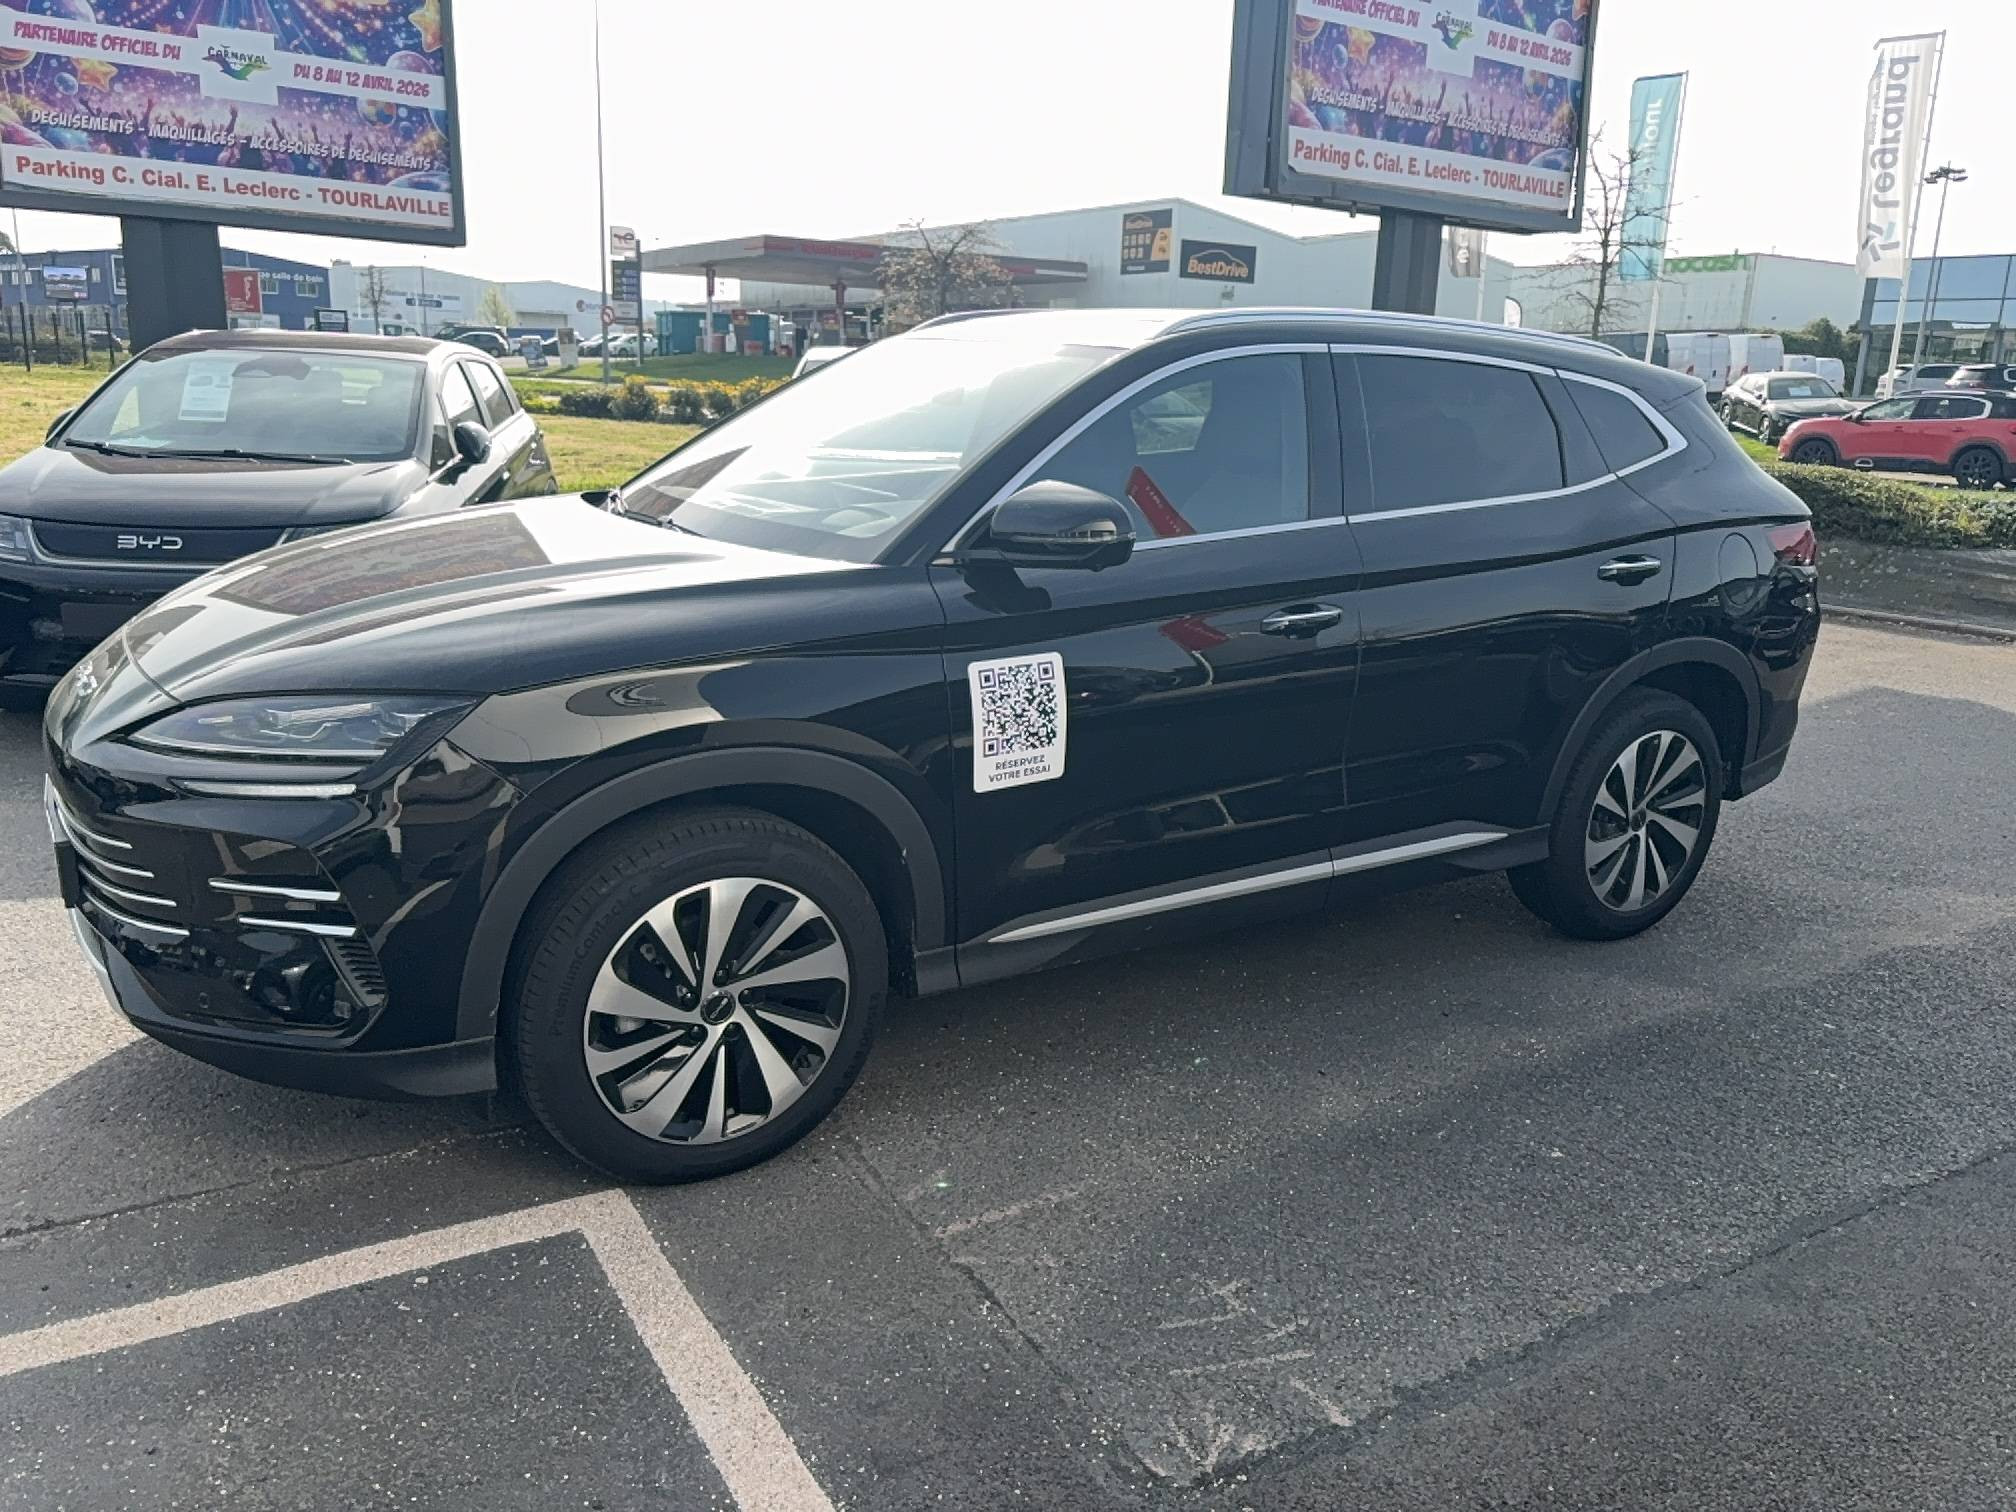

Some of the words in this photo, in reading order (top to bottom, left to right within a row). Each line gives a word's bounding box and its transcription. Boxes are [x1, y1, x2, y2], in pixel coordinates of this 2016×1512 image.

[1407, 10, 1420, 27] DU
[14, 21, 98, 48] PARTENAIRE
[101, 34, 160, 57] OFFICIEL
[162, 44, 182, 60] DU
[294, 63, 310, 79] DU
[313, 66, 323, 81] 8
[325, 67, 343, 84] AU
[346, 71, 361, 87] 12
[362, 74, 394, 92] AVRIL
[396, 79, 430, 97] 2026
[31, 109, 135, 134] DEGUISEMENTS
[148, 123, 236, 146] MAQUILLAGES
[250, 135, 329, 158] ACCESSOIRES
[331, 145, 346, 159] DE
[348, 147, 432, 171] DEGUISEMENTS
[1294, 139, 1350, 170] Parking
[1355, 148, 1369, 168] C.
[1374, 151, 1403, 174] Cial.
[1408, 157, 1420, 176] E.
[1425, 160, 1472, 183] Leclerc
[1483, 169, 1565, 198] TOURLAVILLE
[16, 155, 105, 185] Parking
[112, 165, 135, 184] C.
[142, 169, 189, 189] Cial.
[196, 174, 217, 192] E.
[223, 177, 300, 200] Leclerc
[318, 187, 449, 217] TOURLAVILLE
[1188, 257, 1249, 278] BestDrive
[117, 535, 183, 549] BYD
[988, 770, 1021, 782] VOTRE
[1024, 764, 1051, 776] ESSAI
